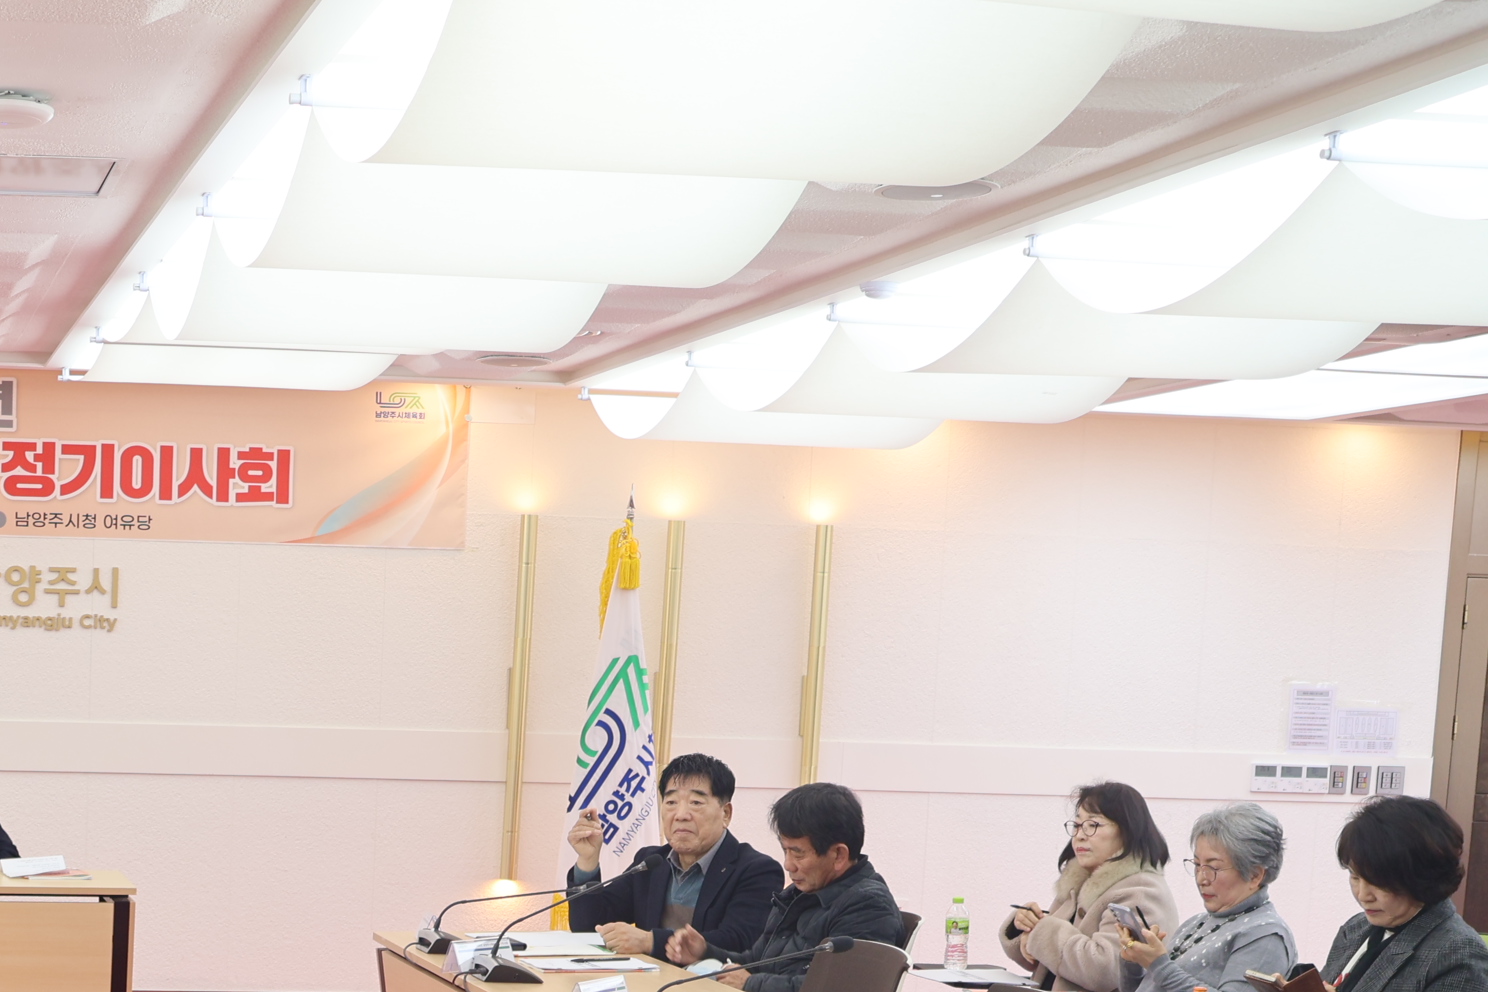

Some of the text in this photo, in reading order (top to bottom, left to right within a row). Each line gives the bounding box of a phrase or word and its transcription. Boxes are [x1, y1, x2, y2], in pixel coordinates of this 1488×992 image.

[1, 440, 291, 505] 정기이사회
[14, 511, 97, 530] 남양주시청
[103, 513, 153, 531] 여유당
[79, 613, 118, 632] City
[597, 733, 655, 845] 남양주시
[613, 796, 654, 858] NAMYANGJU
